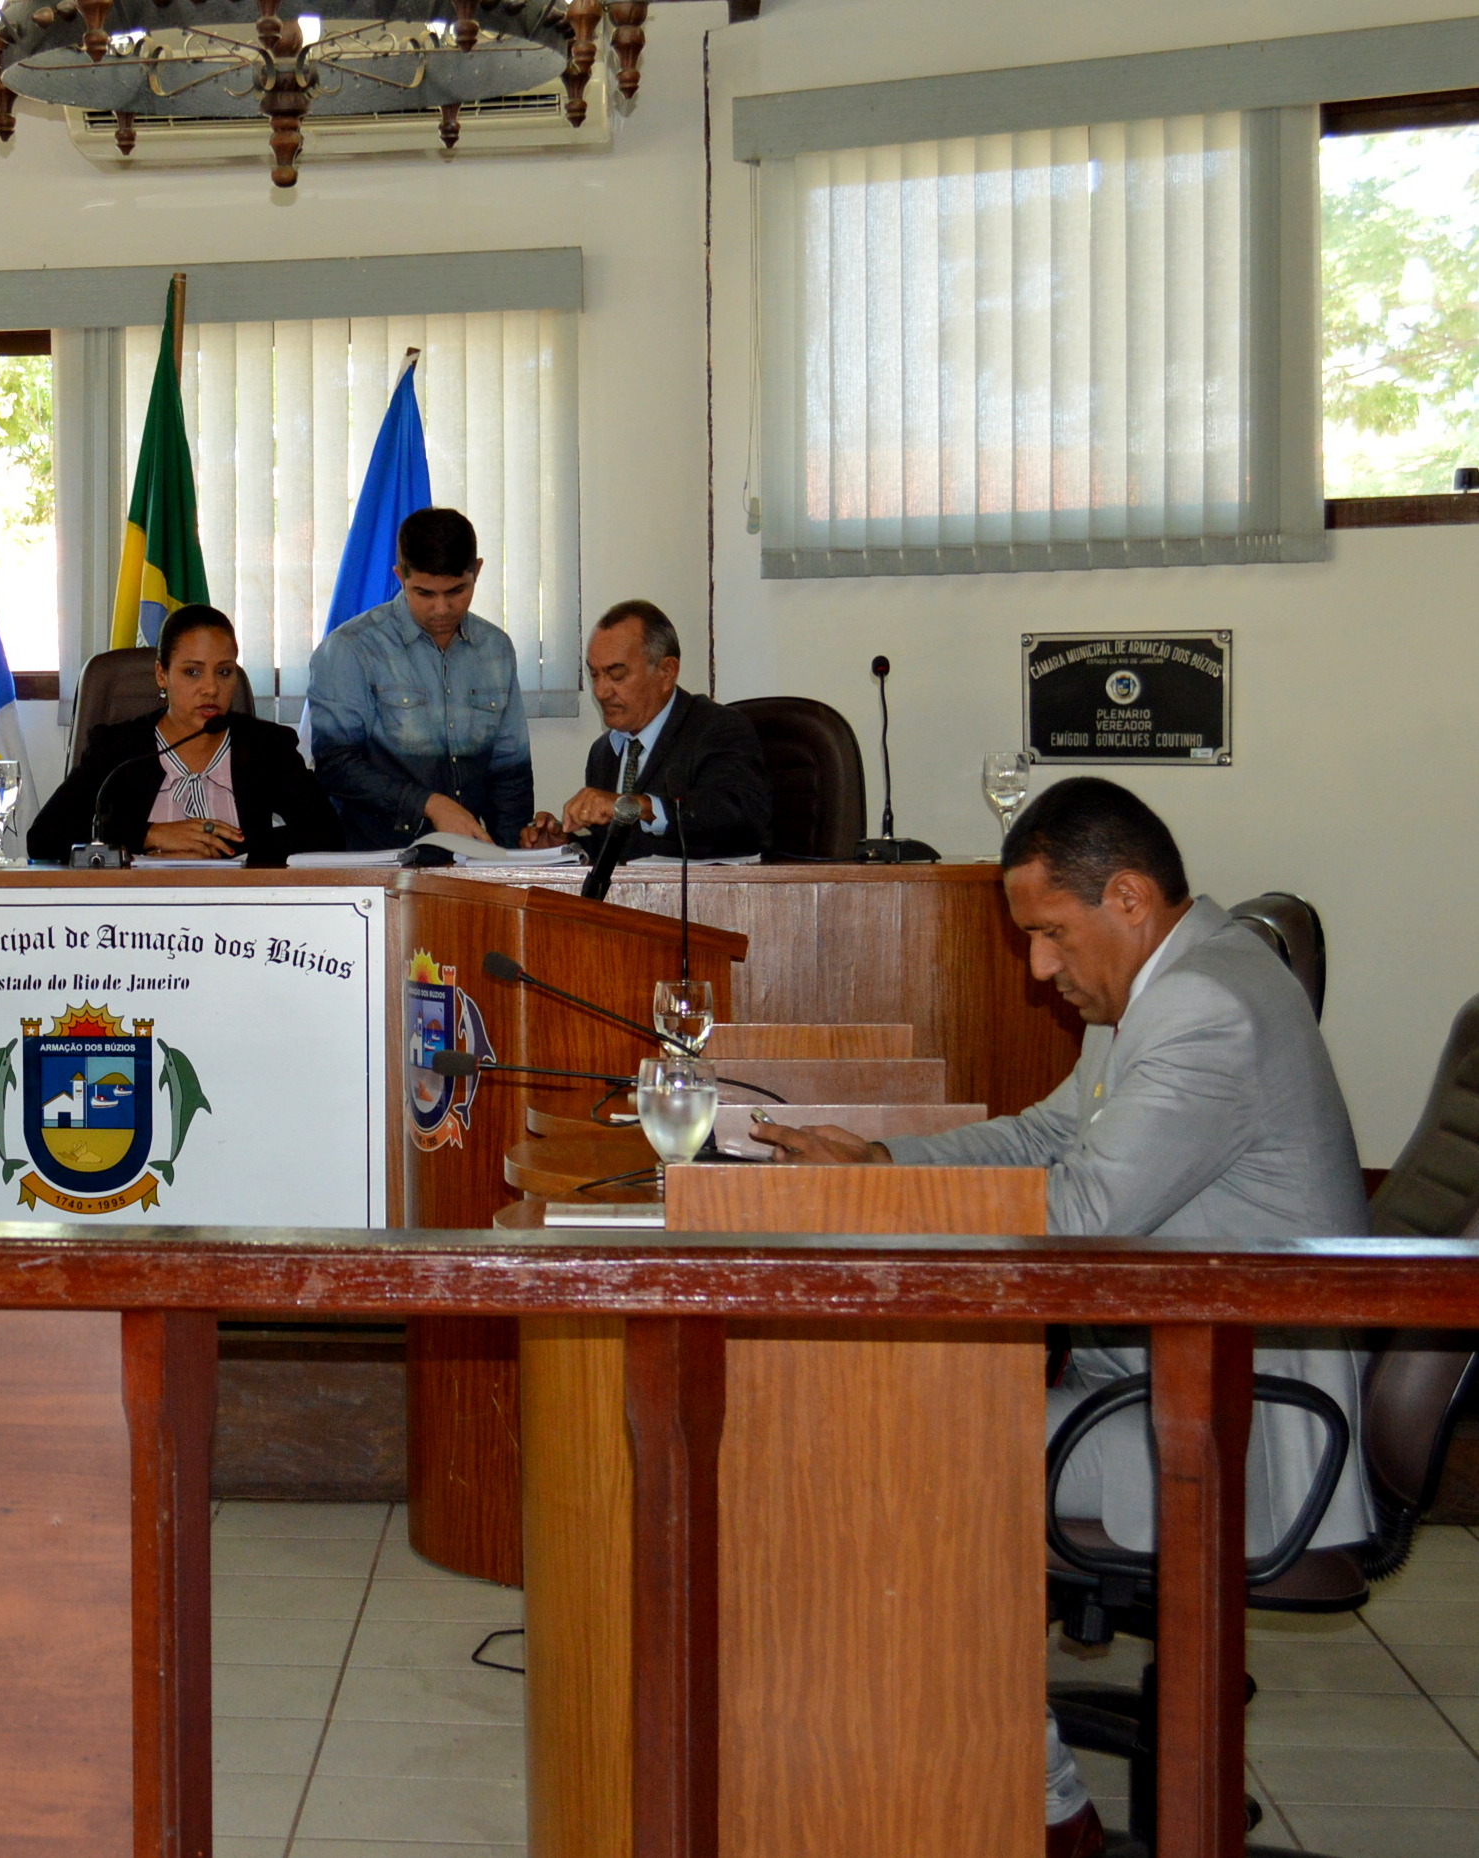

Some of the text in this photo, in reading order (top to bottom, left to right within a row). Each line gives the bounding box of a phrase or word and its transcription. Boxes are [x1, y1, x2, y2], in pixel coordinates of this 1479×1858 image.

[1030, 640, 1223, 680] CÂMARA MUNICIPAL DE ARMAÇÃO DOS BÚZIOS
[1096, 708, 1151, 720] PLENÁRIO
[1095, 720, 1153, 731] VEREADOR
[1050, 731, 1203, 749] EMÍGDIO GONÇALVES COUTINHO
[65, 926, 91, 950] de
[96, 924, 204, 960] Armação
[214, 932, 257, 960] dos
[264, 937, 356, 981] Búzios
[47, 974, 67, 991] do
[72, 973, 100, 991] Rio
[102, 973, 122, 991] de
[126, 973, 191, 993] Janeiro
[40, 1042, 136, 1053] ARMAÇÃO DOS BÚZIOS
[55, 1195, 126, 1210] 1740 1995
